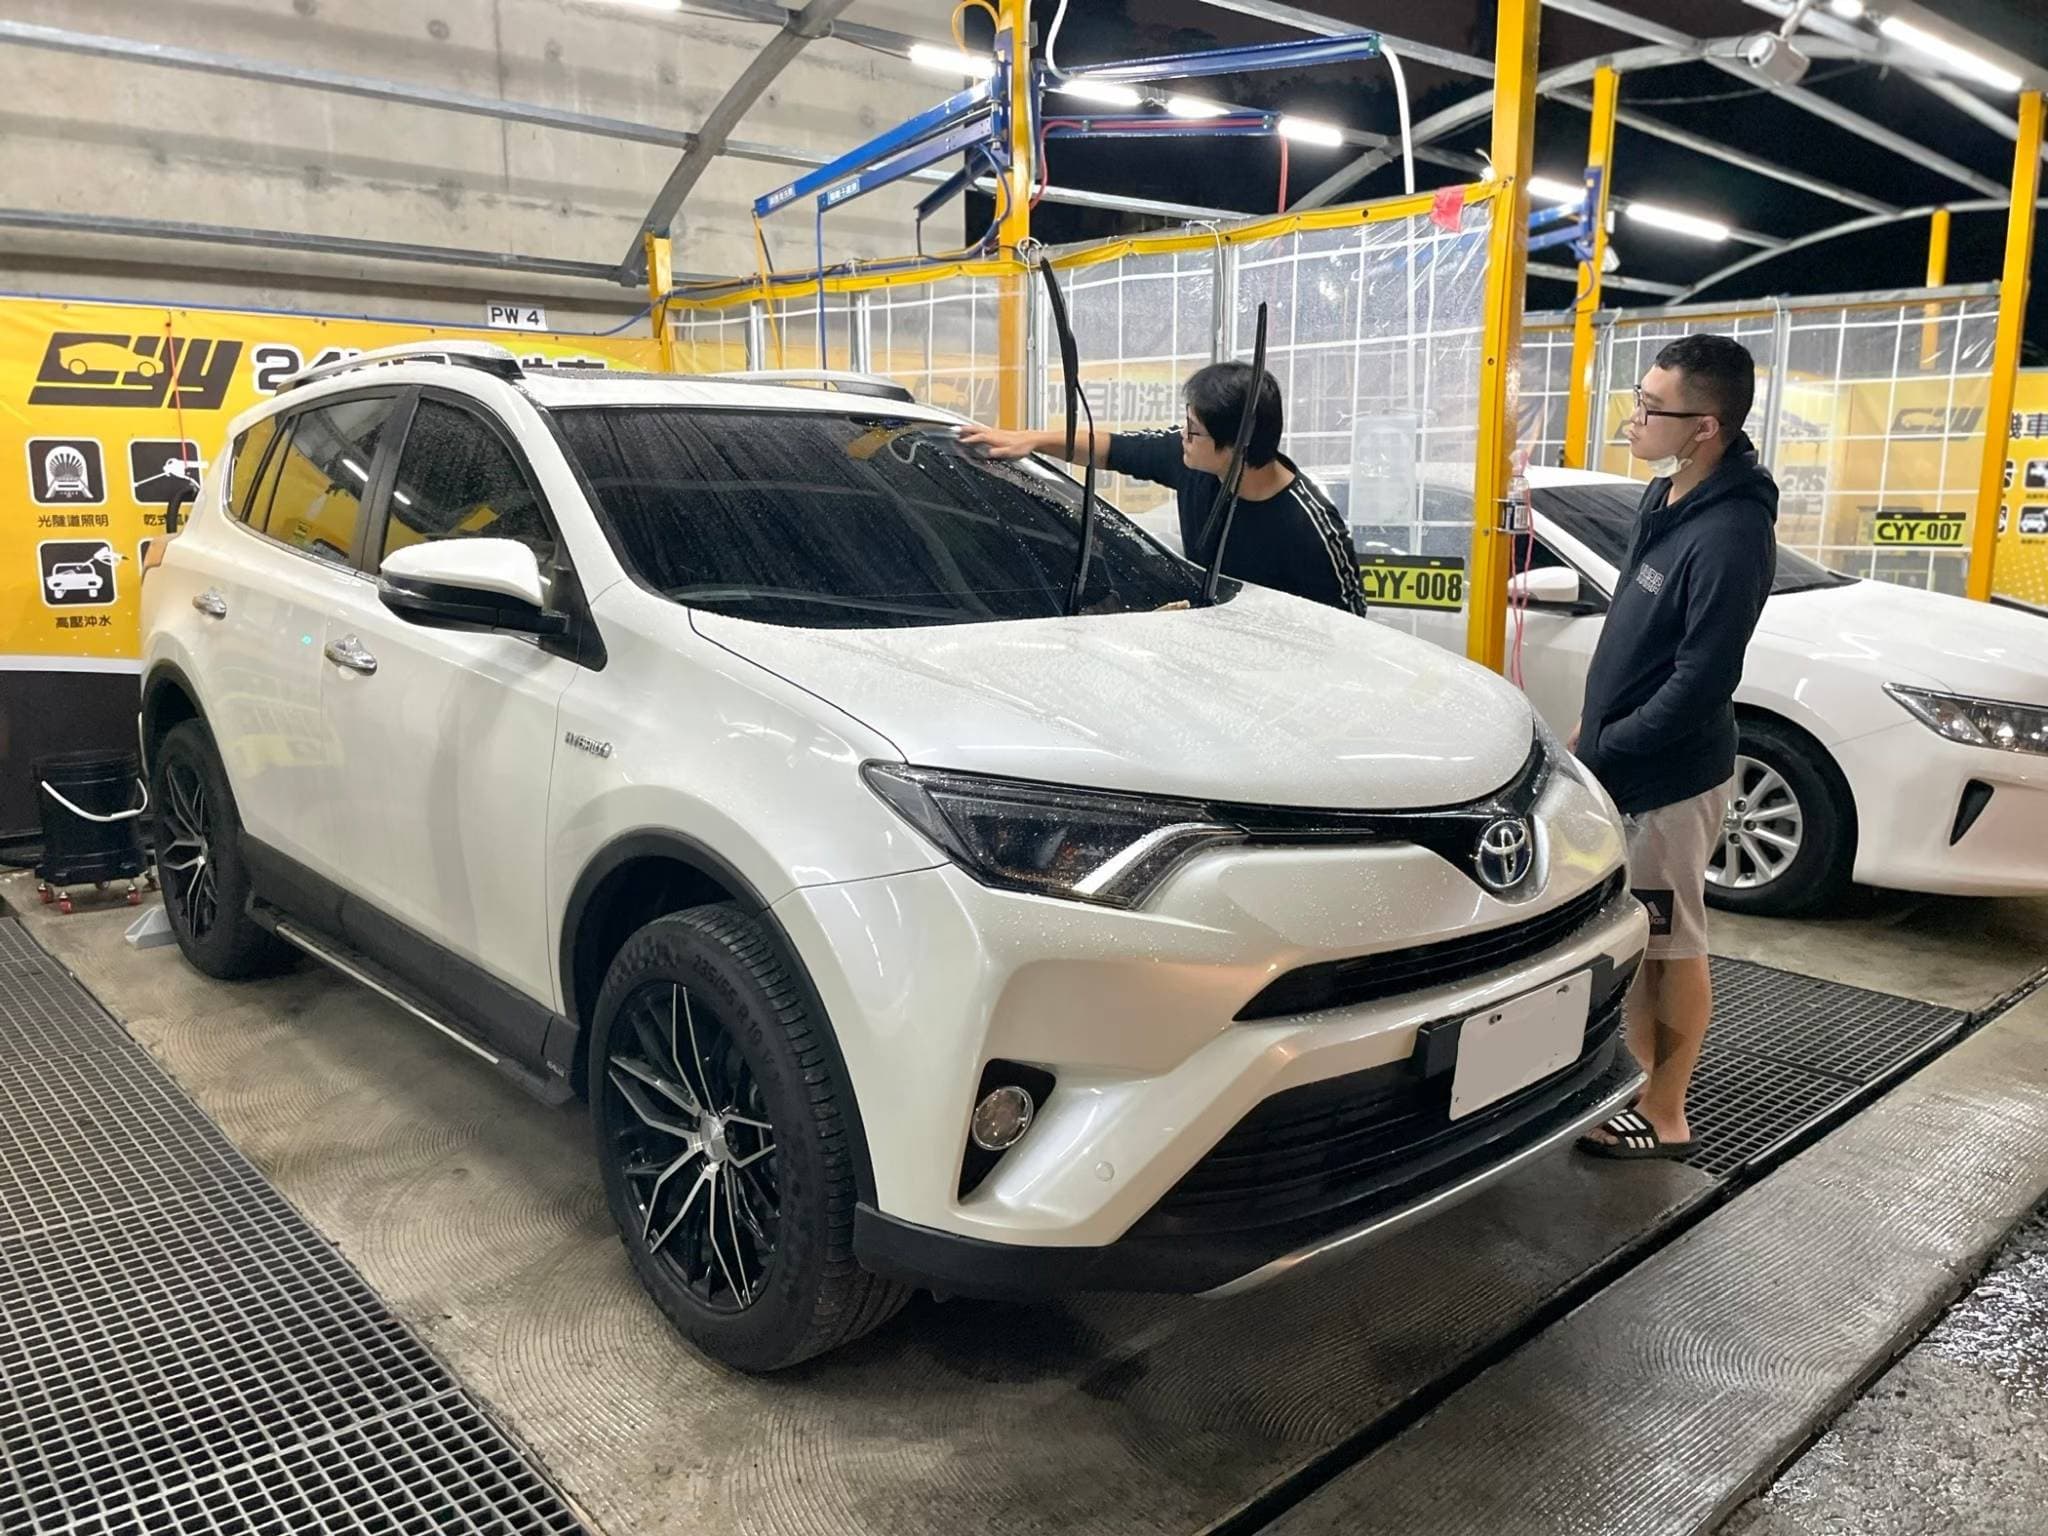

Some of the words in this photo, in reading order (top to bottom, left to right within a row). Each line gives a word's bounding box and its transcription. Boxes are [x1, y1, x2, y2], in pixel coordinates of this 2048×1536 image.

[491, 307, 518, 324] PW
[526, 310, 539, 325] 4
[1877, 522, 1962, 541] CYY-007
